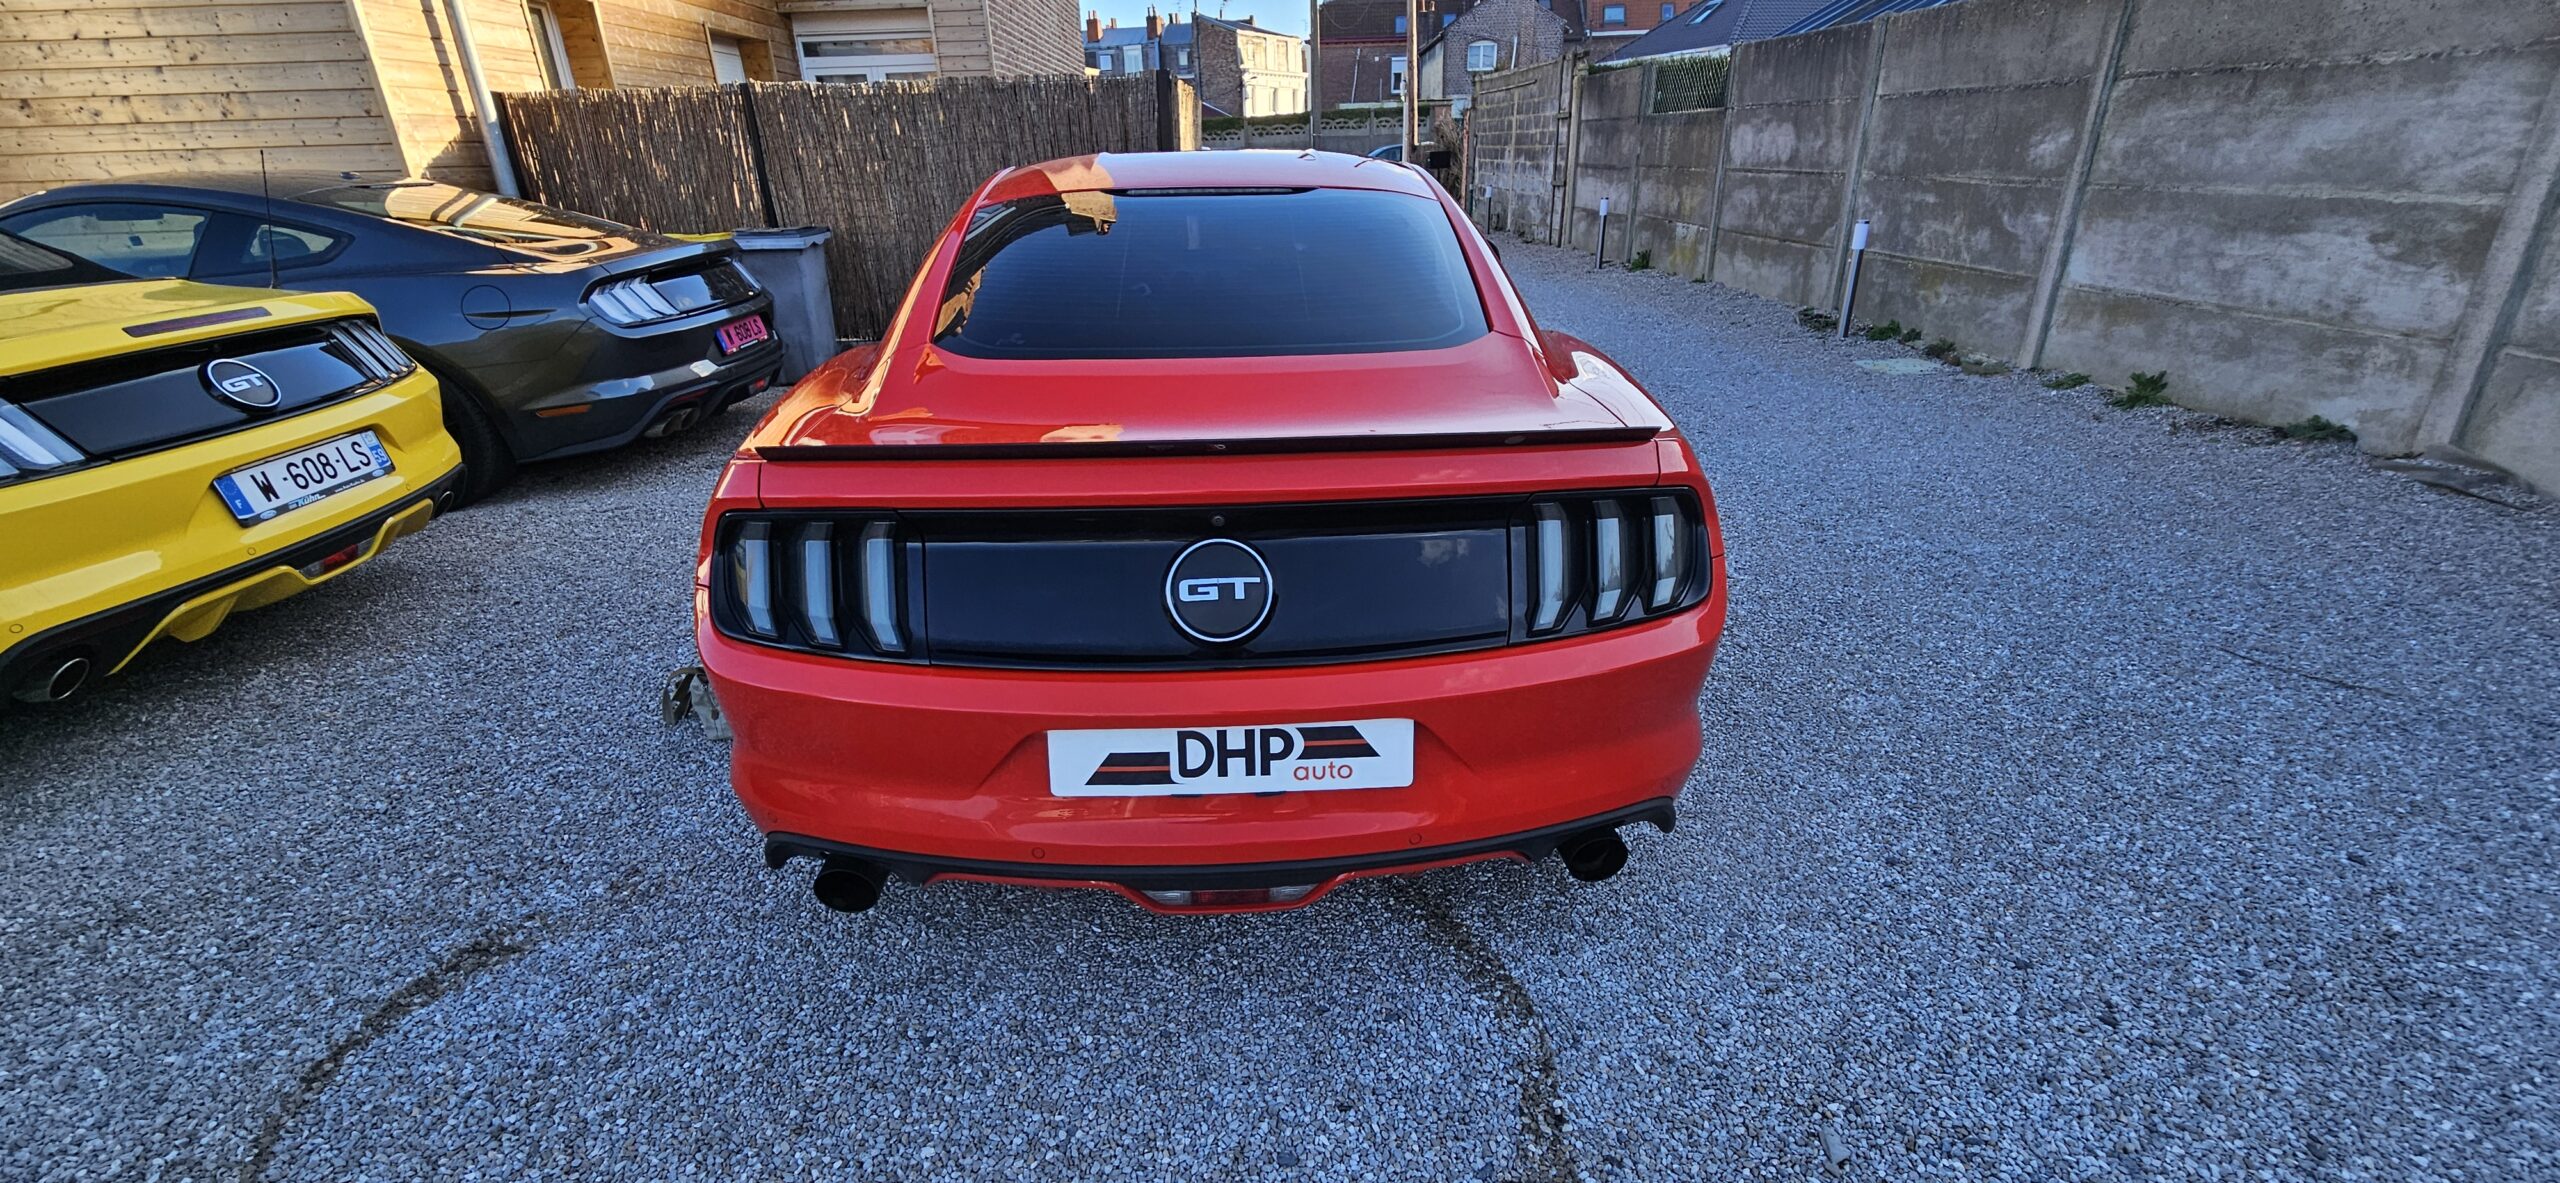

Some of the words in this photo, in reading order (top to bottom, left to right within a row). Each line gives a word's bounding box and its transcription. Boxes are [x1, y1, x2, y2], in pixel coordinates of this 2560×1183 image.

[221, 373, 264, 393] GT
[373, 447, 388, 464] 59
[234, 499, 244, 510] F
[1178, 576, 1261, 602] GT
[1176, 727, 1295, 779] DHP
[1293, 760, 1354, 782] auto
